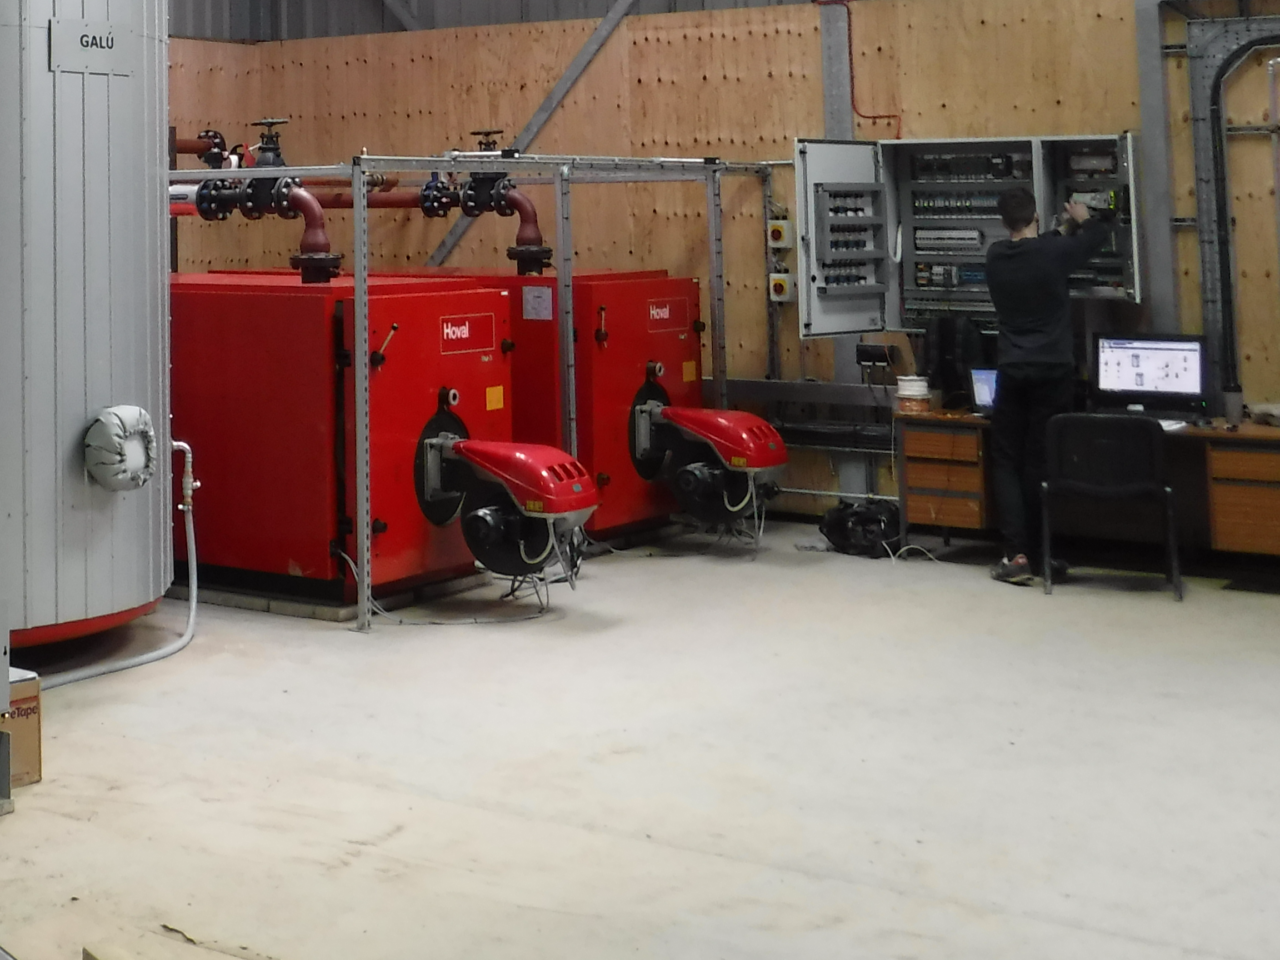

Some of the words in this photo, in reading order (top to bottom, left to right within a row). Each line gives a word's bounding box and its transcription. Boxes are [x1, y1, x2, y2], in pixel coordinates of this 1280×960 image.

[80, 31, 114, 50] GALÚ
[649, 304, 670, 320] Hoval
[443, 320, 469, 340] Hoval
